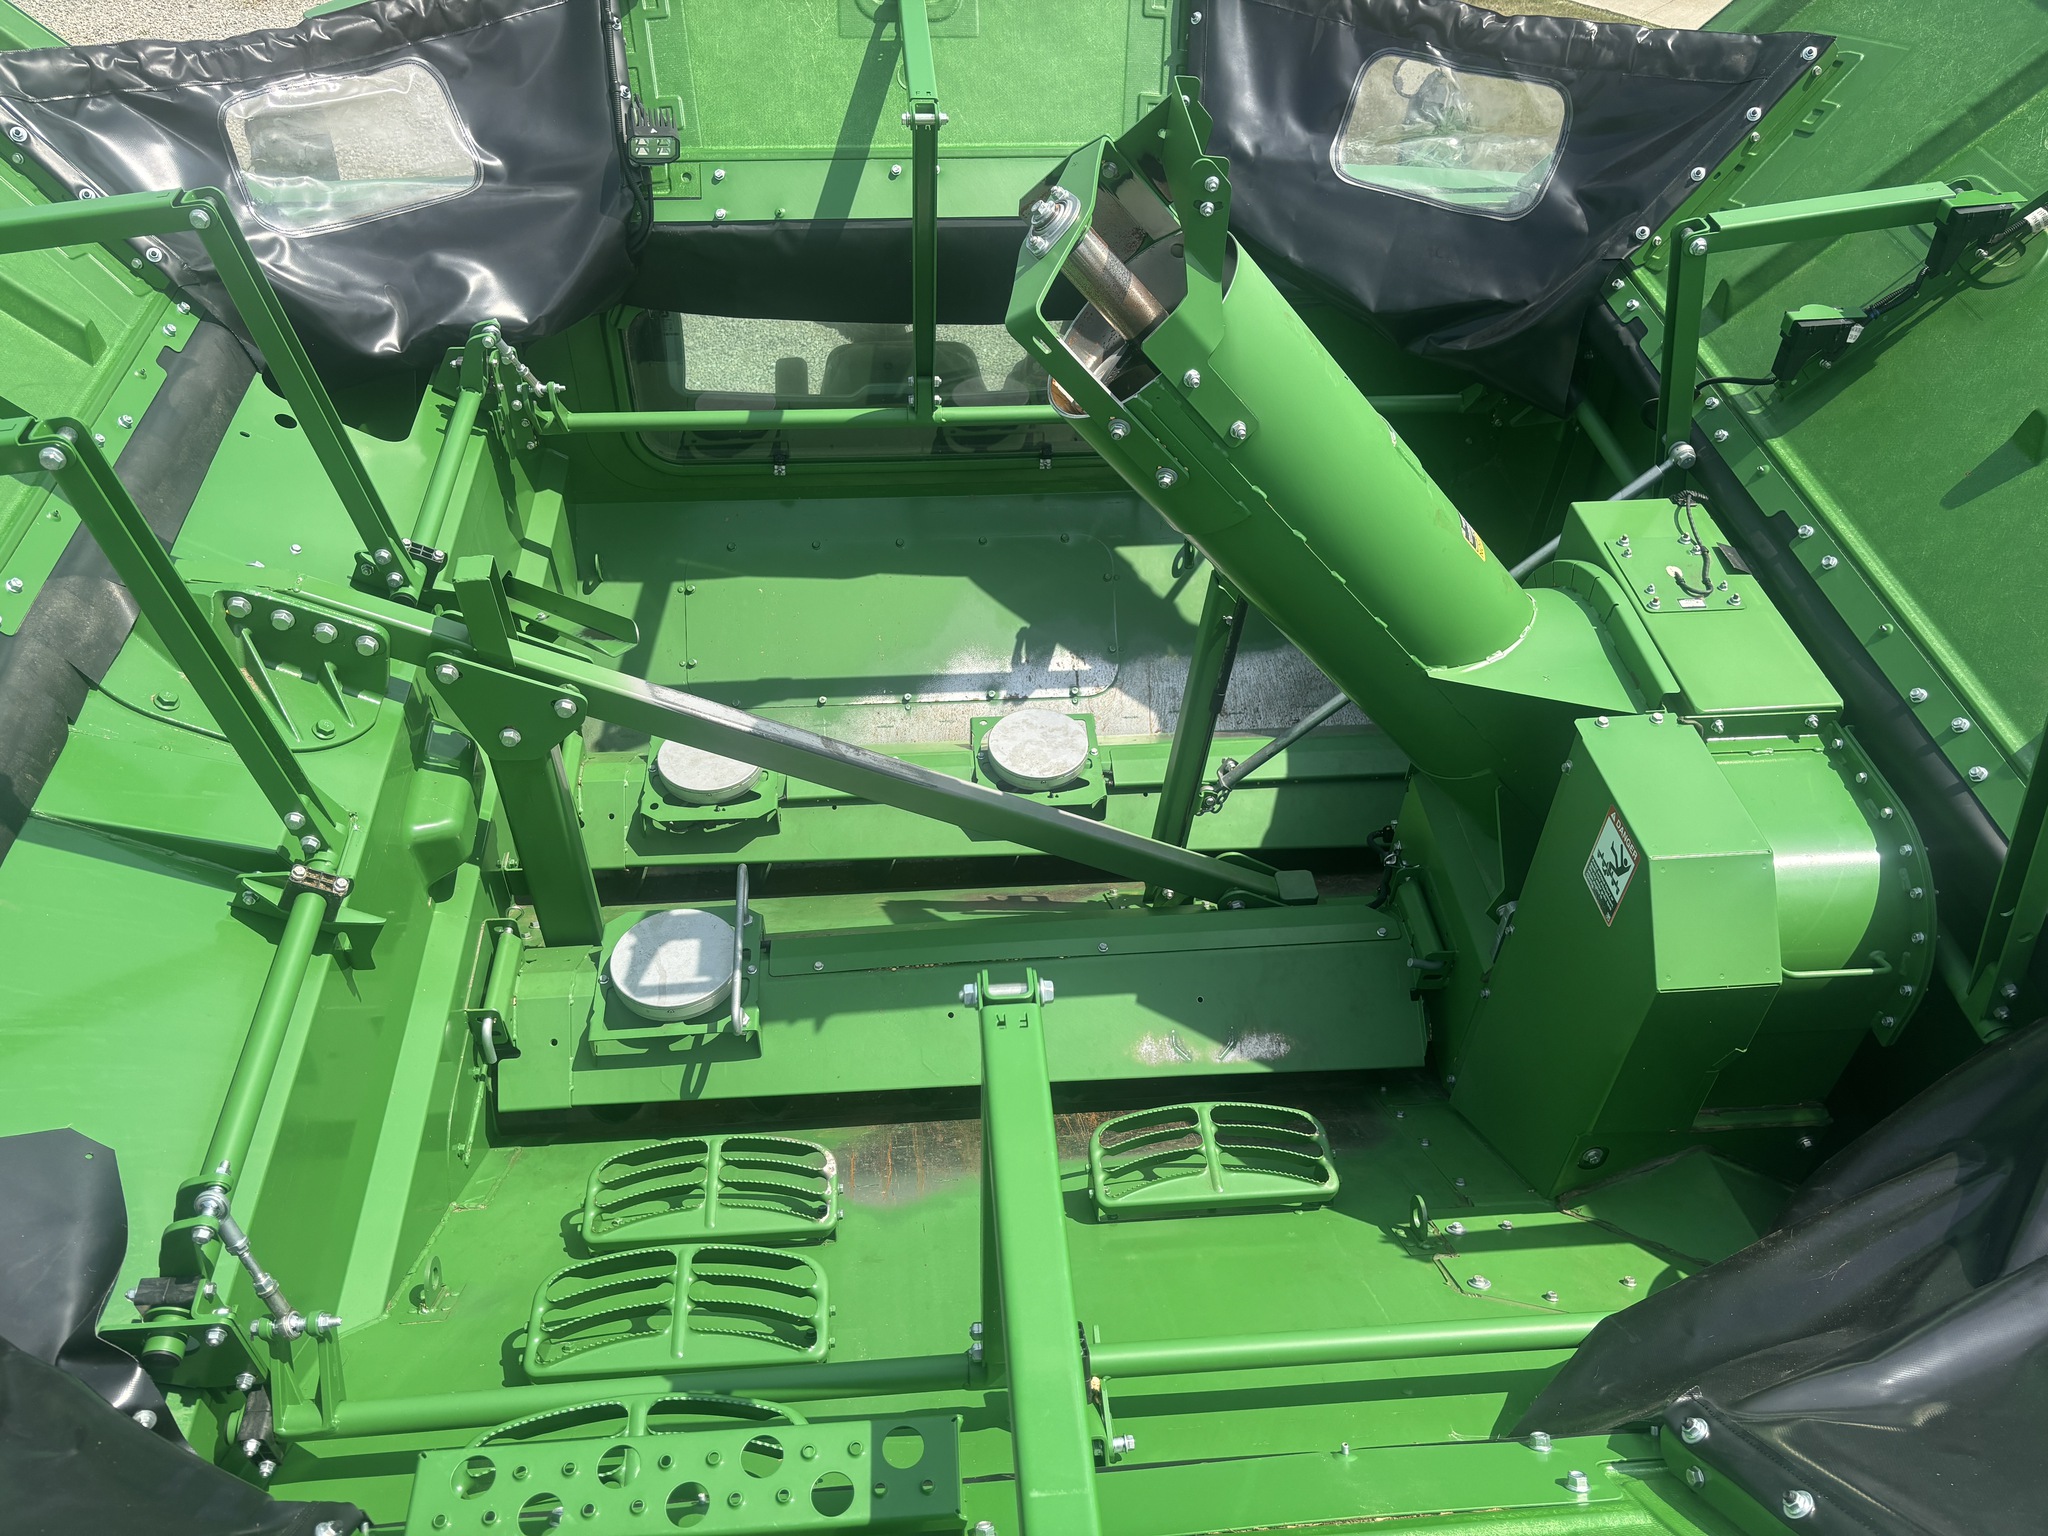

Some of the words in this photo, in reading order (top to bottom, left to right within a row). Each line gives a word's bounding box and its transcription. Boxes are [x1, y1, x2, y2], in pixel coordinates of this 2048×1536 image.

[1615, 818, 1638, 861] DANGER
[996, 1013, 1006, 1029] R
[1019, 1012, 1029, 1028] F
